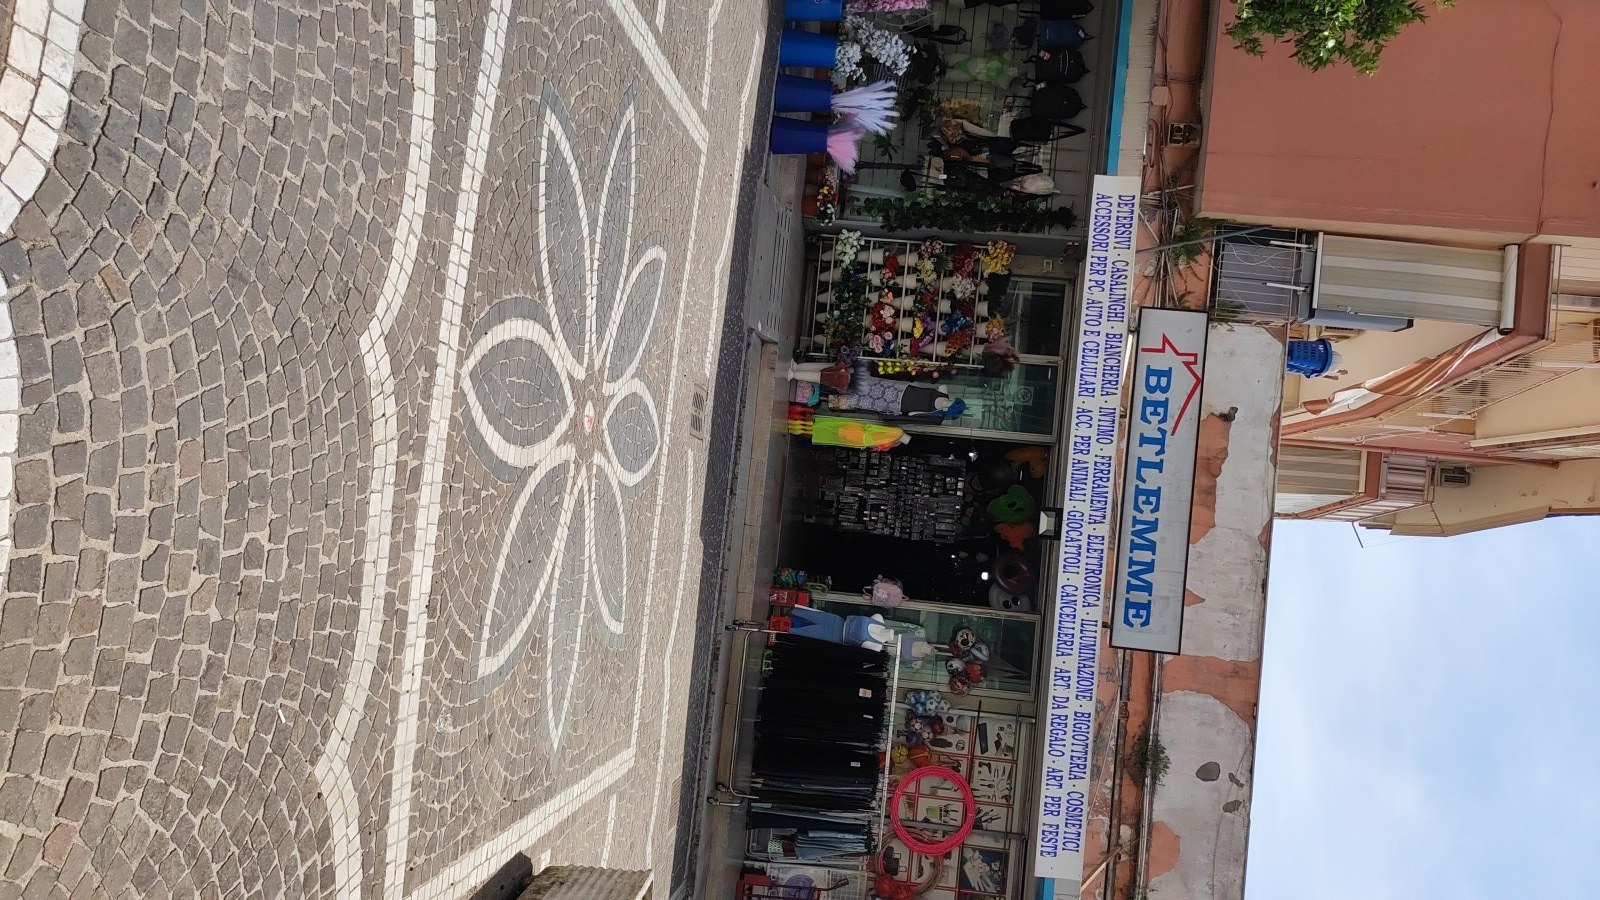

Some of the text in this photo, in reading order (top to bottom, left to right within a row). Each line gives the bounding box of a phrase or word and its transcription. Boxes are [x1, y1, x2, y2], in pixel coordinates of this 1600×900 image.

[1091, 193, 1113, 252] ACCESSORI
[1089, 255, 1107, 279] PER
[1084, 298, 1103, 326] AUTO
[1078, 340, 1101, 398] CELLULARI
[1073, 434, 1092, 455] PER
[1068, 458, 1089, 503] ANIMALI
[1123, 365, 1172, 628] BETLEMME
[1062, 195, 1134, 853] DETERSIVI CASALINGHI BIANCHERIA INTIMO FERRAMENTA ELETTRONICA ILLUMINAZIONE BIGIOTTERIA COSMETICI
[1063, 509, 1086, 575] GIOCATTOLI
[1056, 584, 1079, 657] CANCELLERIA
[1052, 695, 1069, 710] DA
[1048, 713, 1068, 758] REGALO
[1043, 795, 1063, 817] PER
[1040, 823, 1060, 857] FESTE
